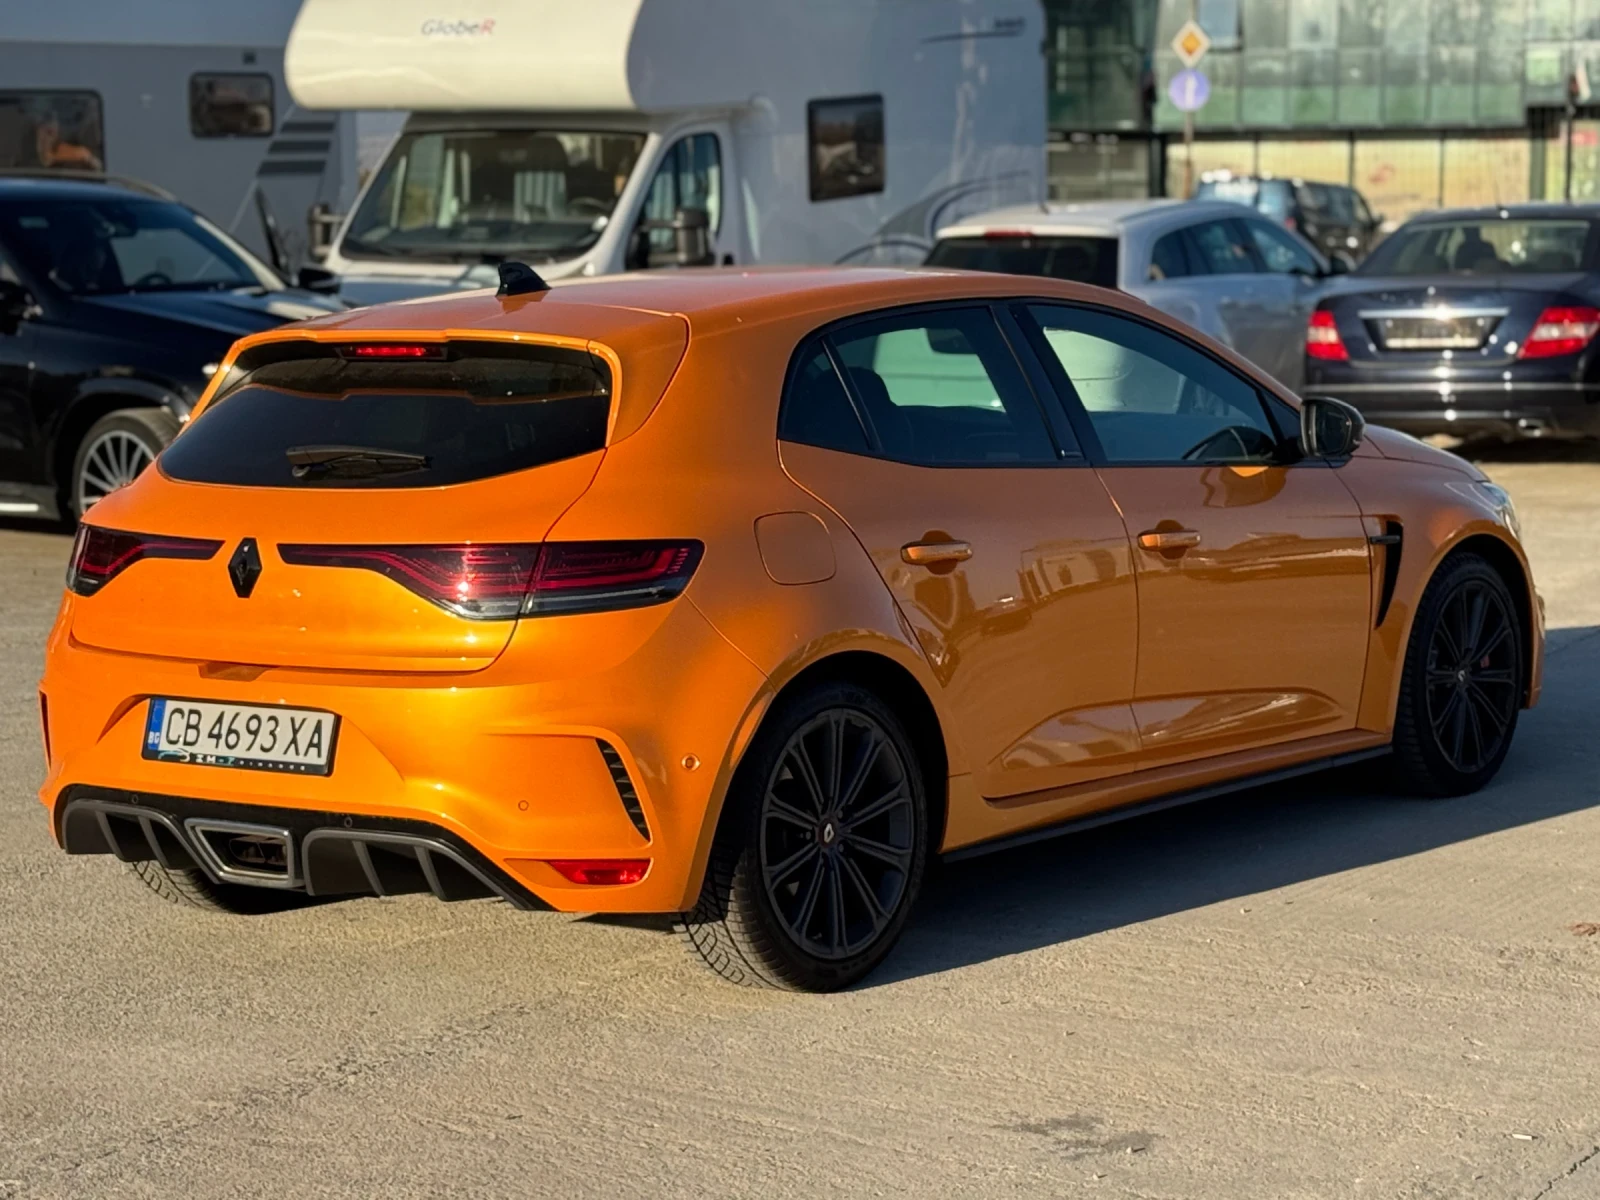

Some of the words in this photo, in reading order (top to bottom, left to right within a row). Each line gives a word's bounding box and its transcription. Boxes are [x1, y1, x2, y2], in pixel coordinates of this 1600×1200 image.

[148, 731, 161, 745] BG
[165, 707, 202, 747] CB
[207, 710, 280, 753] 4693
[283, 716, 323, 758] XA
